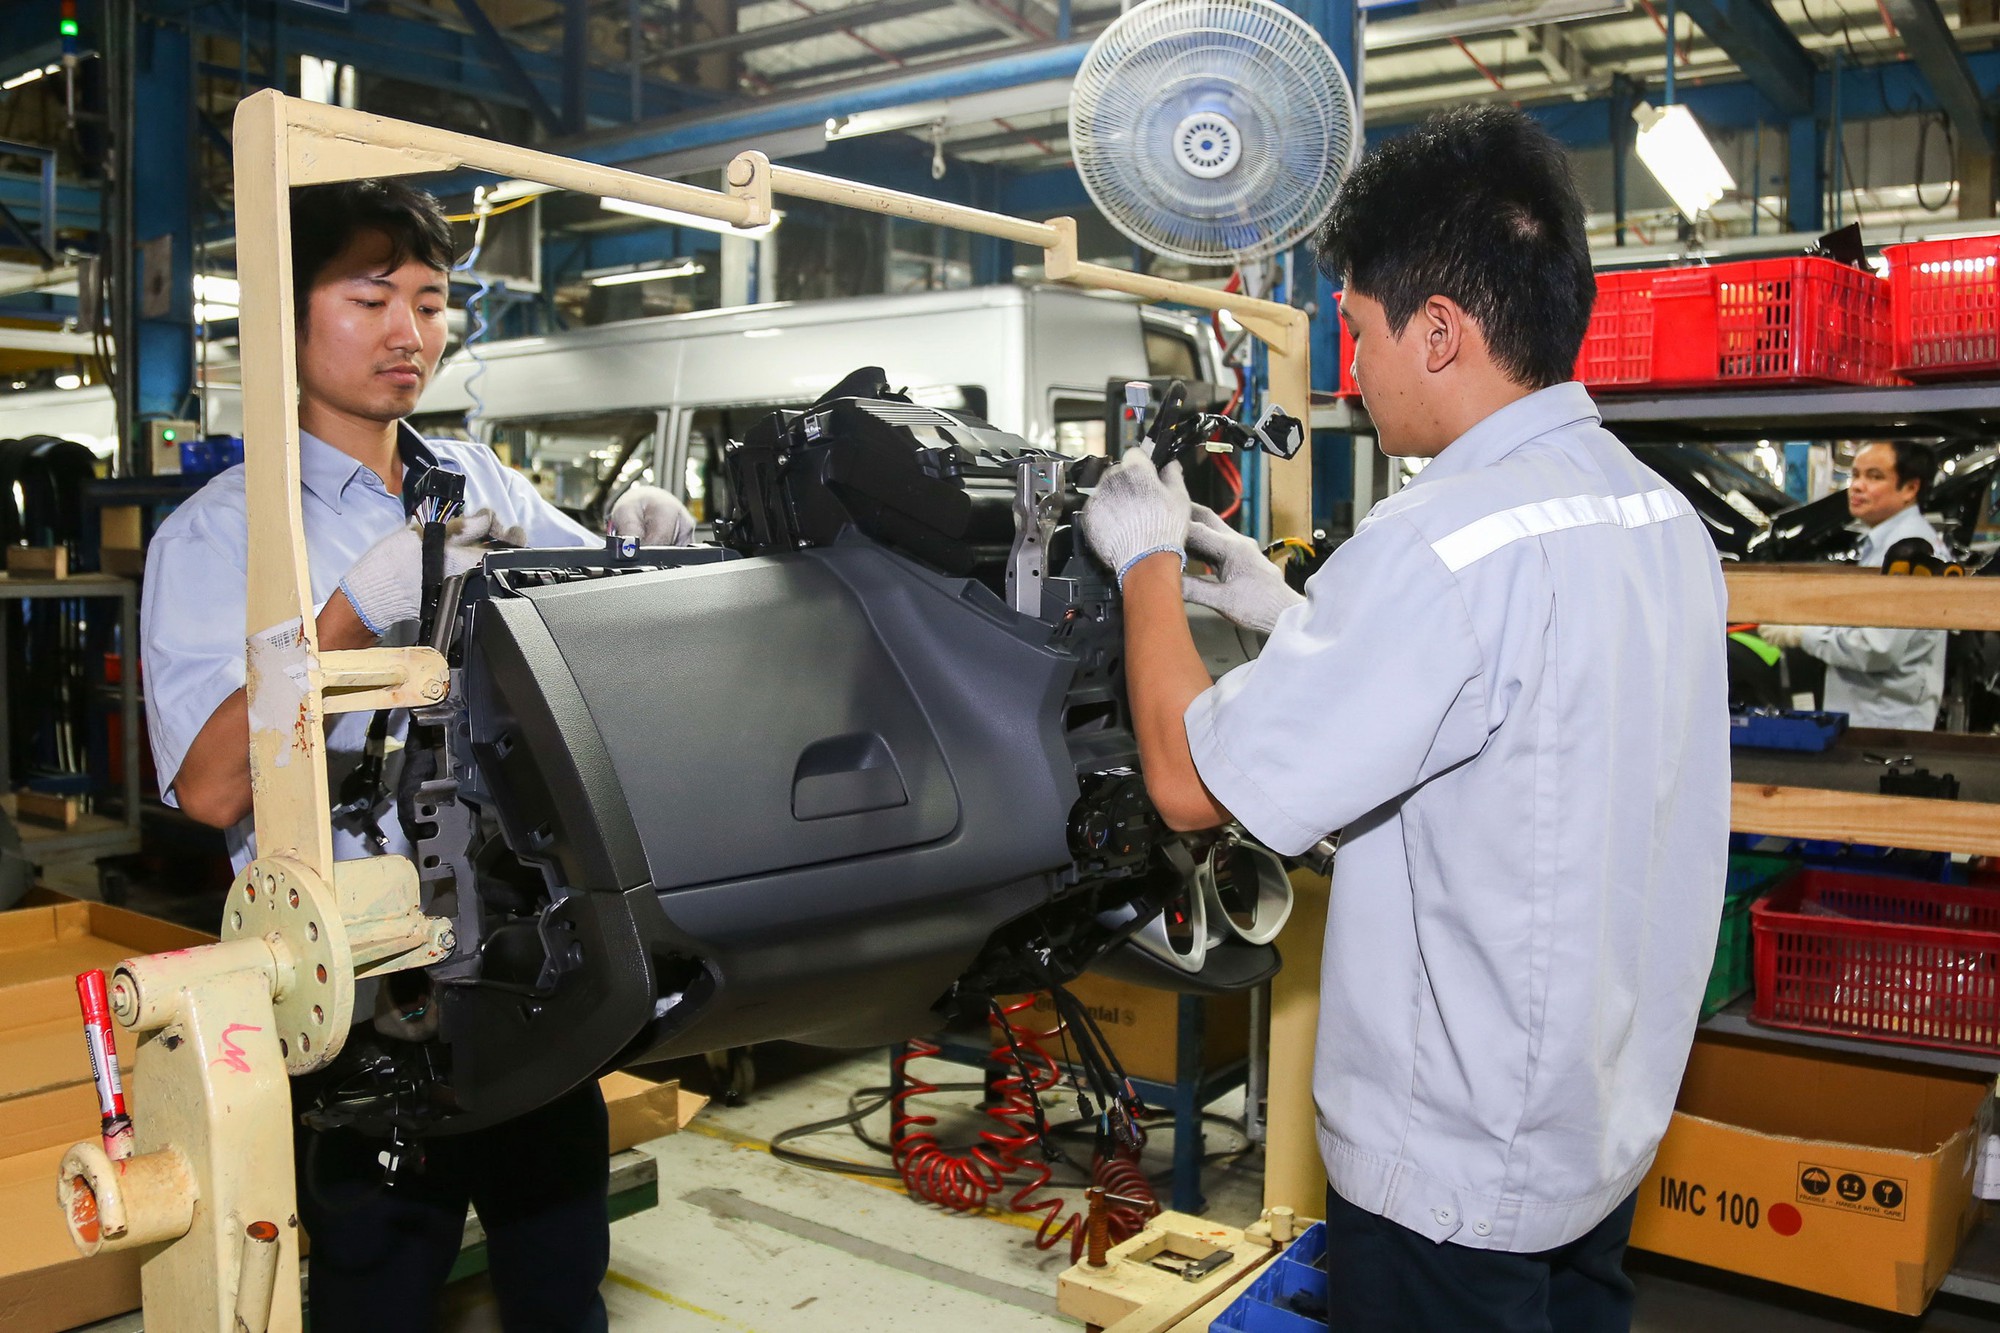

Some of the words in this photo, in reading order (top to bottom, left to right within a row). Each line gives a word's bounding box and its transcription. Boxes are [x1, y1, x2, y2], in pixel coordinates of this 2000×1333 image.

[1660, 1175, 1706, 1216] IMC
[1716, 1190, 1759, 1229] 100
[1884, 1210, 1902, 1218] CARE
